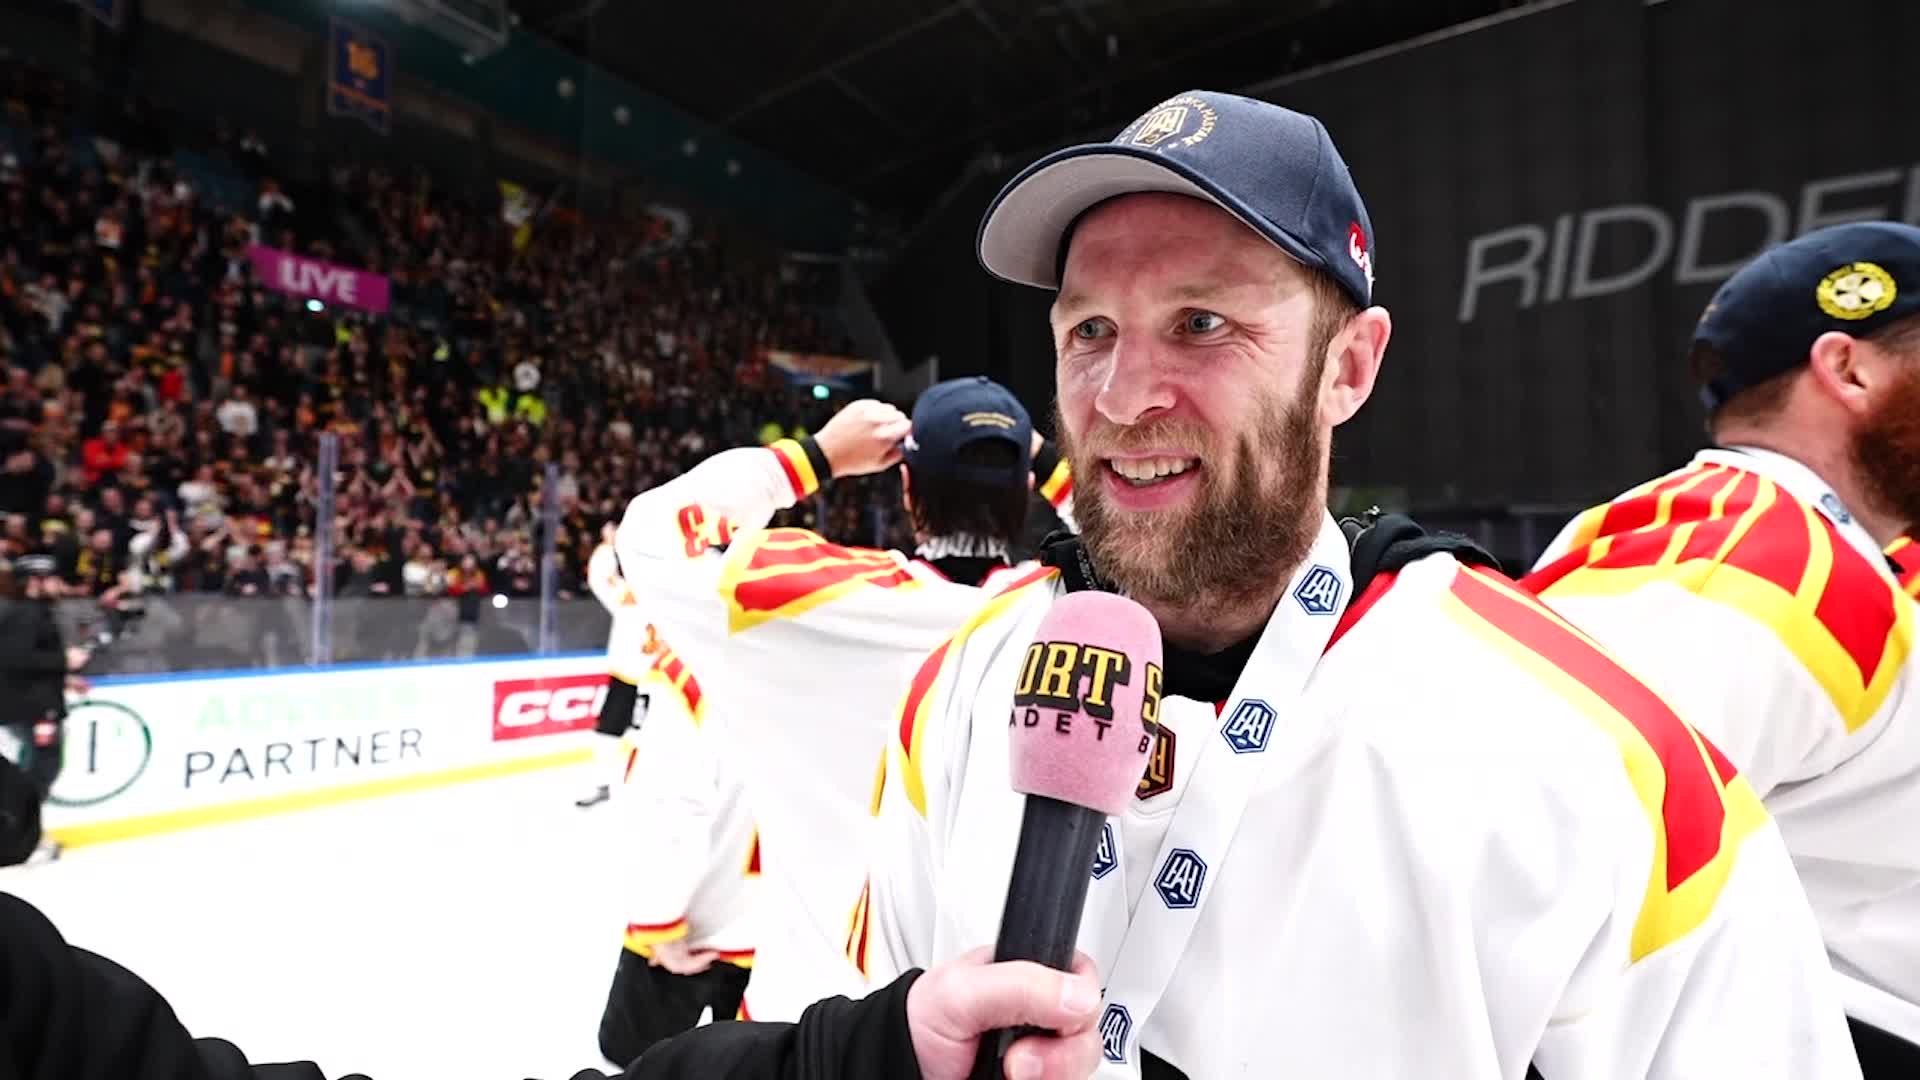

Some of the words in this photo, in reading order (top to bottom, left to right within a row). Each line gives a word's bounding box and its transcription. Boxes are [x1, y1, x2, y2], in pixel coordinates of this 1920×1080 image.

[1458, 166, 1920, 323] RIDDE
[278, 257, 357, 304] LIVE
[183, 727, 423, 789] PARTNER
